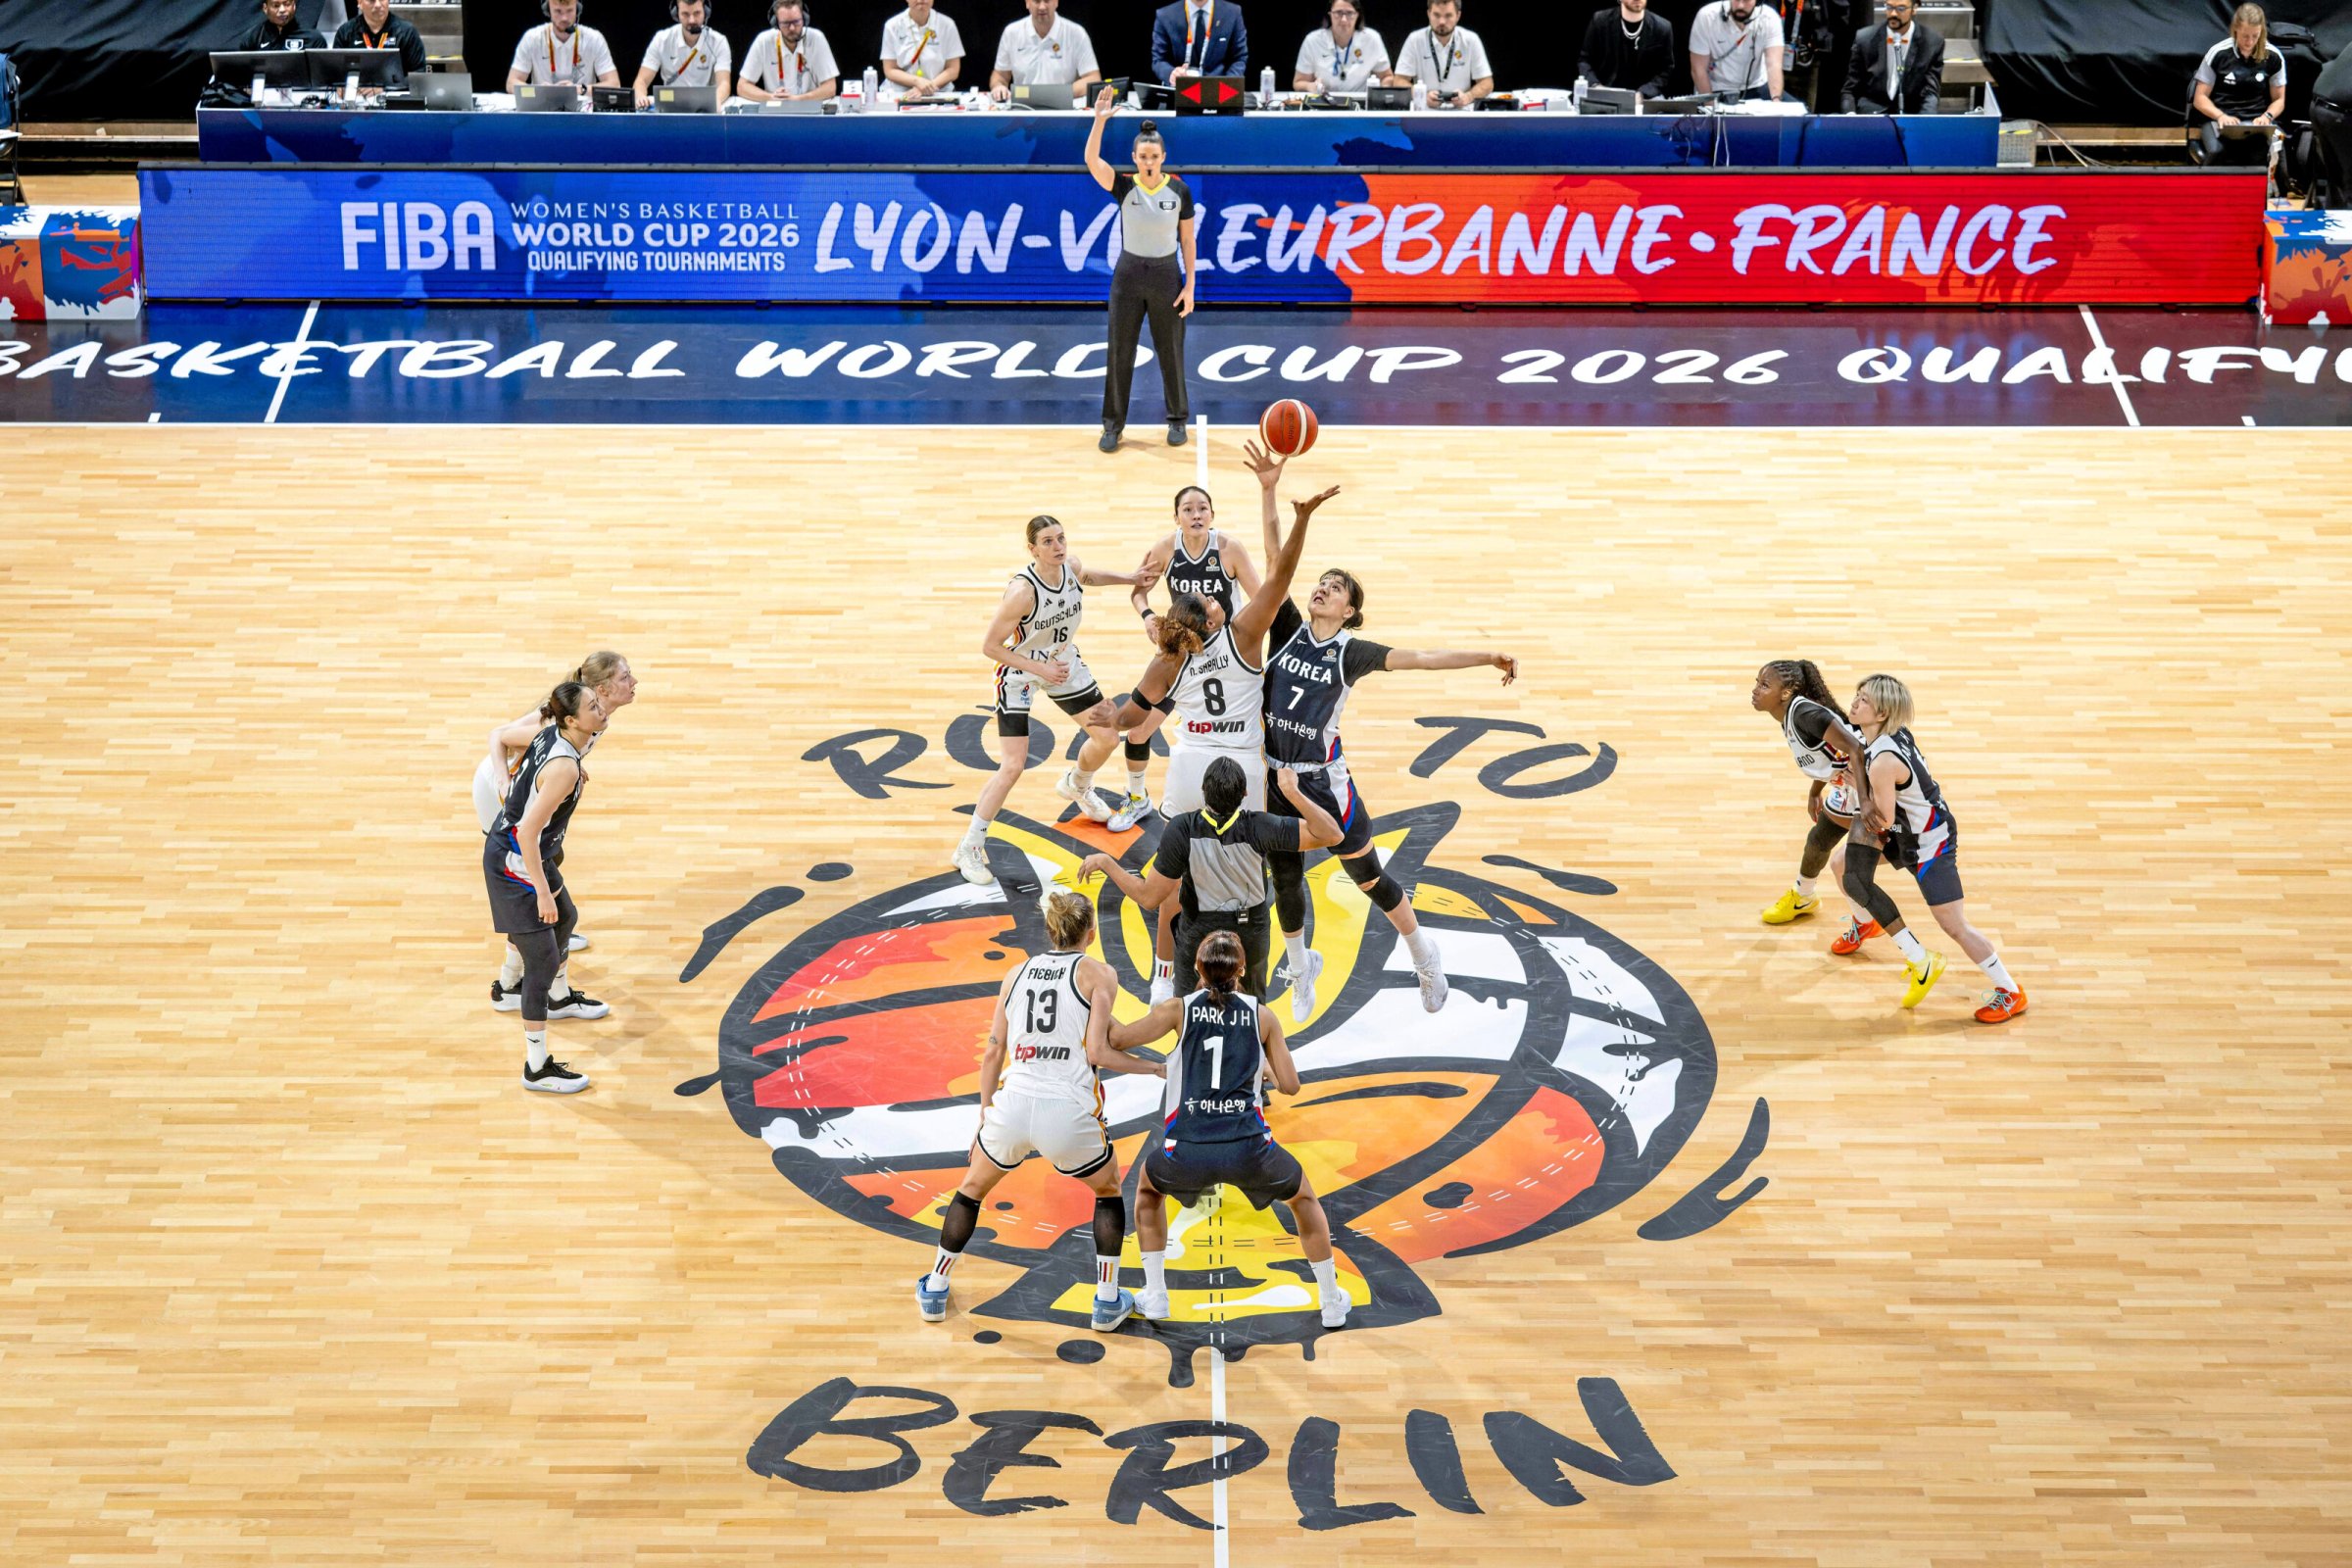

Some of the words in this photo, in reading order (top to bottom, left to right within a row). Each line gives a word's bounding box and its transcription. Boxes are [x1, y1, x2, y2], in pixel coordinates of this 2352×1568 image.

[511, 201, 631, 220] WOMEN'S
[640, 202, 801, 220] BASKETBALL
[341, 200, 497, 271] FIBA
[511, 222, 635, 248] WORLD
[643, 222, 711, 248] CUP
[718, 223, 801, 248] 2026
[813, 201, 1684, 276] LYON-VLEURBANNE
[1731, 203, 2068, 276] FRANCE
[527, 250, 639, 273] QUALIFYING
[643, 251, 786, 272] TOURNAMENTS
[735, 339, 1154, 380] WORLD
[1198, 344, 1463, 383] CUP
[1495, 349, 1788, 384] 2026
[1170, 576, 1224, 594] KOREA
[1035, 601, 1082, 630] DEUTSCHLAN
[1054, 626, 1068, 643] 16
[1030, 649, 1058, 664] IN
[1278, 652, 1333, 685] KOREA
[1202, 677, 1226, 716] 8
[1287, 685, 1304, 710] 7
[1188, 720, 1246, 734] tipwin
[1277, 717, 1317, 741] 하나은행
[1411, 715, 1619, 800] TO
[1026, 988, 1058, 1034] 13
[1192, 1005, 1225, 1026] PARK
[1014, 1043, 1070, 1063] tipwin
[1203, 1035, 1224, 1090] 1
[1200, 1099, 1247, 1114] 하나은행
[746, 1376, 1679, 1531] BERLIN
